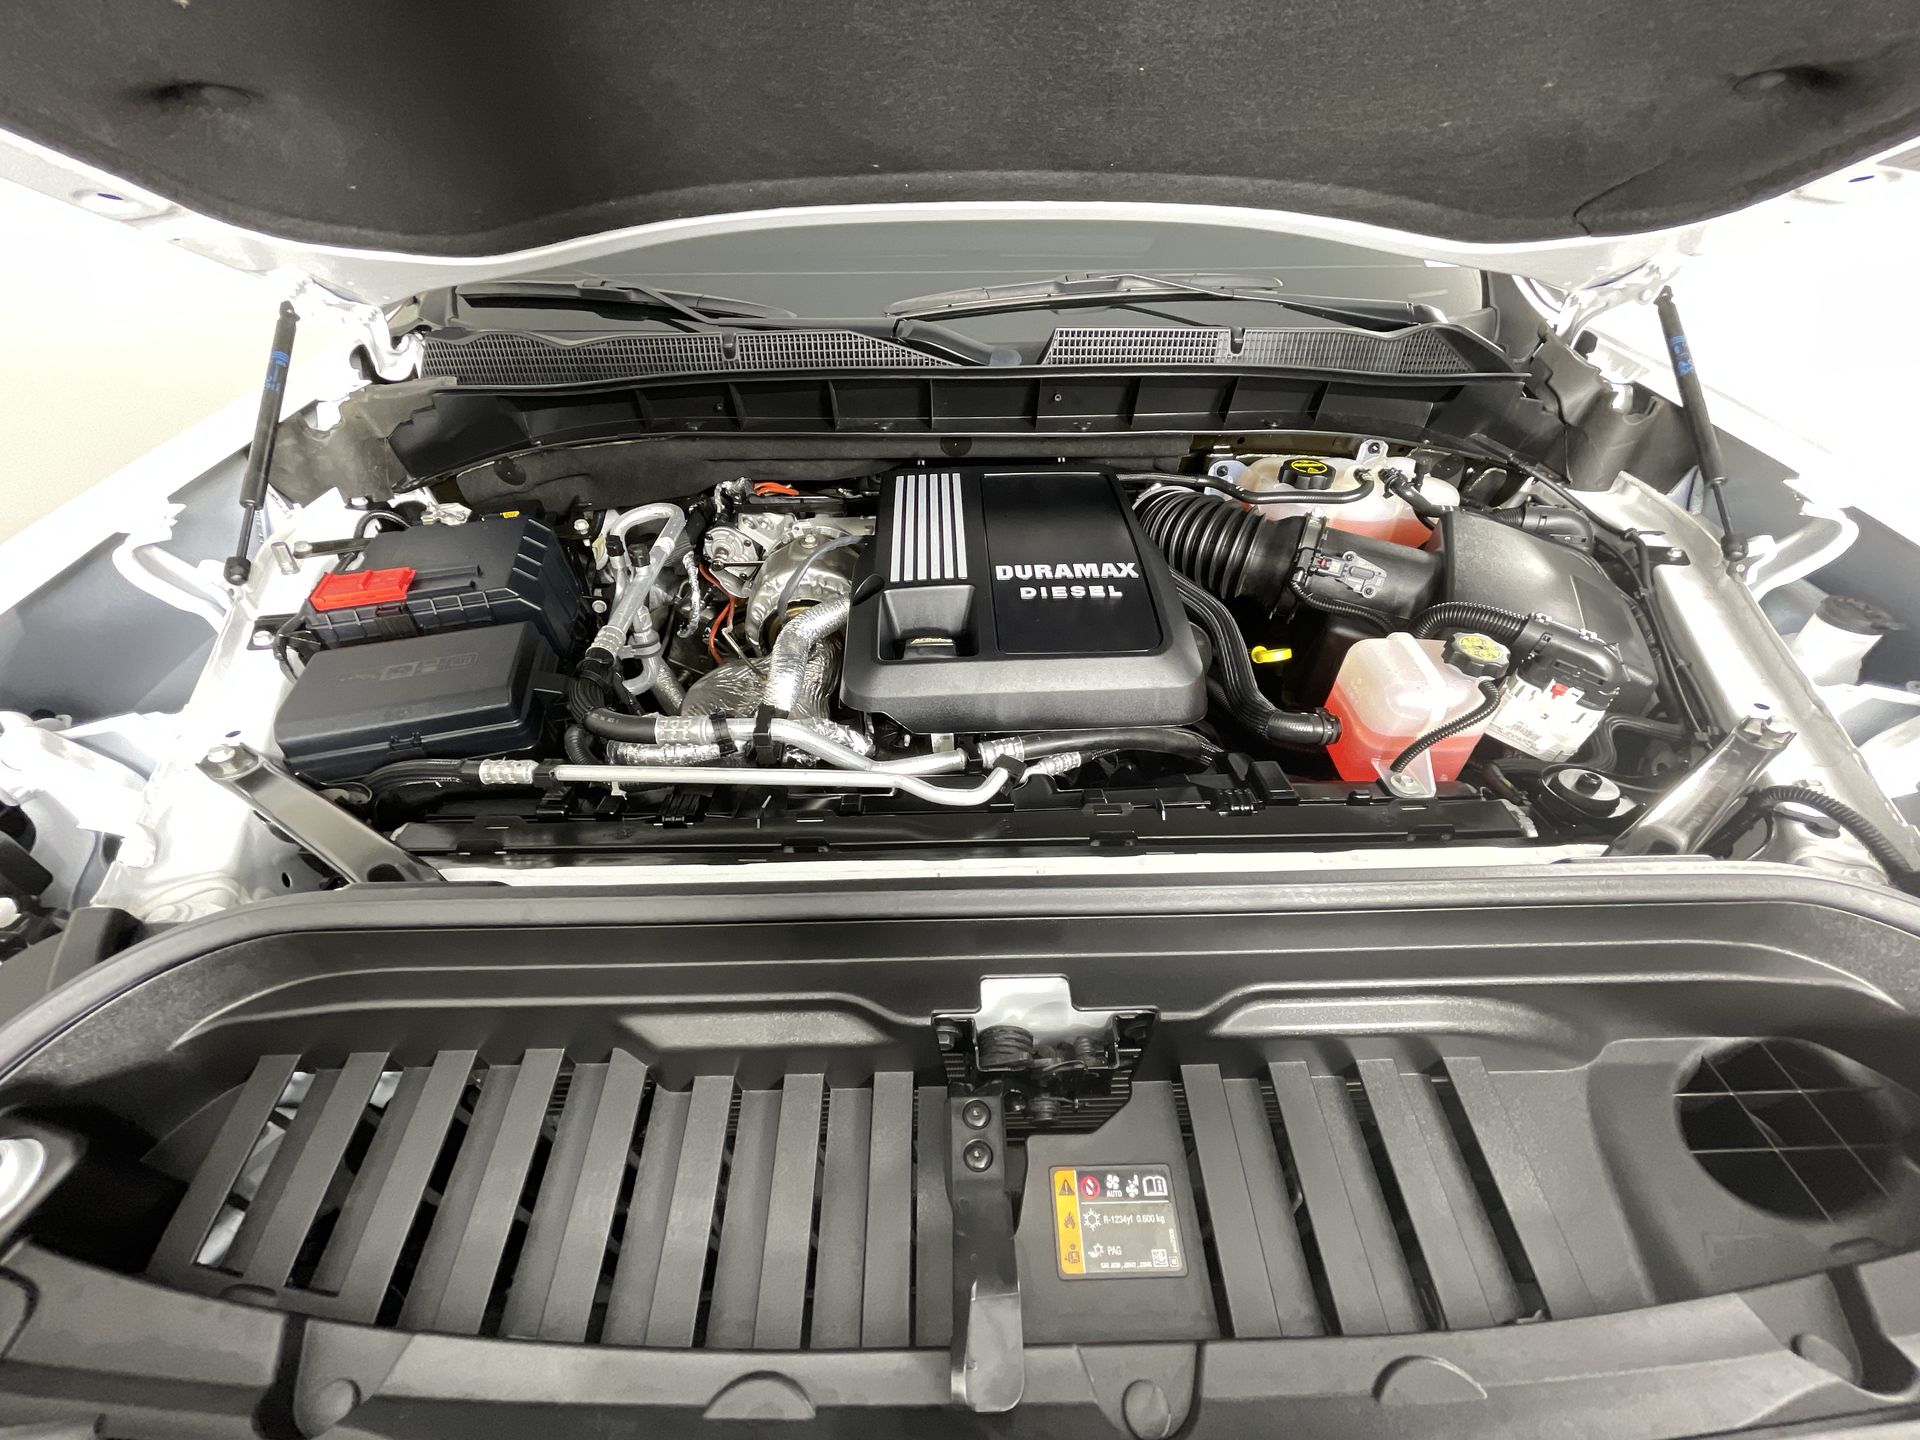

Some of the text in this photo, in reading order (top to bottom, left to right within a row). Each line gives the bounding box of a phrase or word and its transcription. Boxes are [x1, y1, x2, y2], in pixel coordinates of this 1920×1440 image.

[995, 562, 1139, 580] DURAMAX
[1020, 585, 1123, 600] DIESEL
[1106, 1189, 1123, 1198] AUTO
[1155, 1213, 1166, 1225] kg
[1107, 1245, 1122, 1256] PAG
